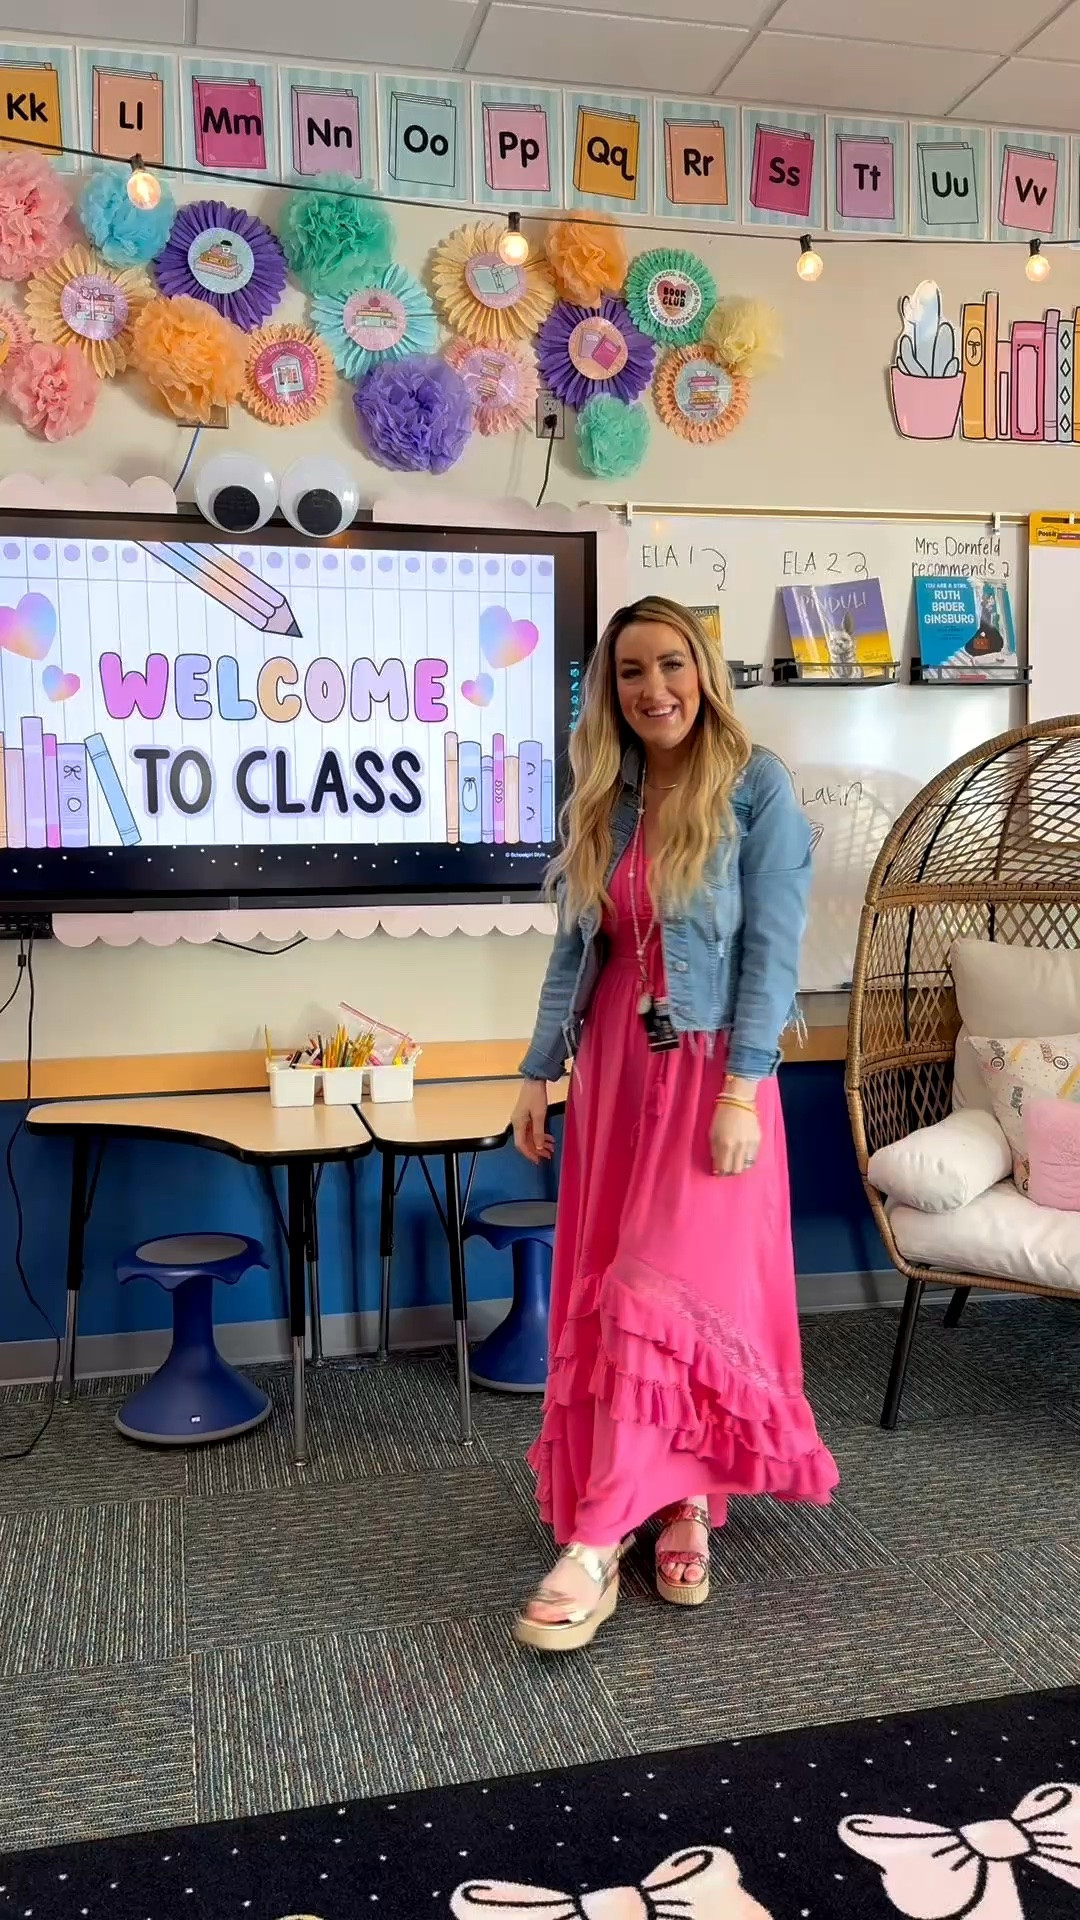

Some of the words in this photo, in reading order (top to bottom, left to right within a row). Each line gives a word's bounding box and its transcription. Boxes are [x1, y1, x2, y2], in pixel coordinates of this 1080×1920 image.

[6, 92, 48, 122] Kk
[119, 101, 143, 131] Ll
[202, 106, 262, 136] Mm
[307, 117, 353, 149] Nn
[403, 124, 449, 157] Oo
[498, 131, 540, 168] Pp
[587, 136, 635, 181] Qq
[683, 148, 714, 177] Rr
[769, 156, 801, 187] Ss
[853, 163, 881, 192] Tt
[931, 171, 969, 198] Uu
[1015, 175, 1048, 206] Vv
[662, 296, 685, 307] CLUB
[663, 287, 686, 298] BOOK
[642, 545, 679, 568] ELA
[689, 545, 694, 565] 1
[915, 536, 939, 555] Mrs
[944, 536, 1001, 557] Dornfeld
[782, 550, 817, 575] ELA
[826, 552, 843, 573] 2
[911, 558, 996, 578] recommends
[800, 591, 867, 613] PINDULI
[931, 602, 965, 612] BADER
[934, 590, 961, 600] RUTH
[924, 614, 975, 624] GINSBURG
[99, 652, 448, 723] WELCOME
[132, 747, 214, 815] TO
[235, 747, 422, 815] CLASS
